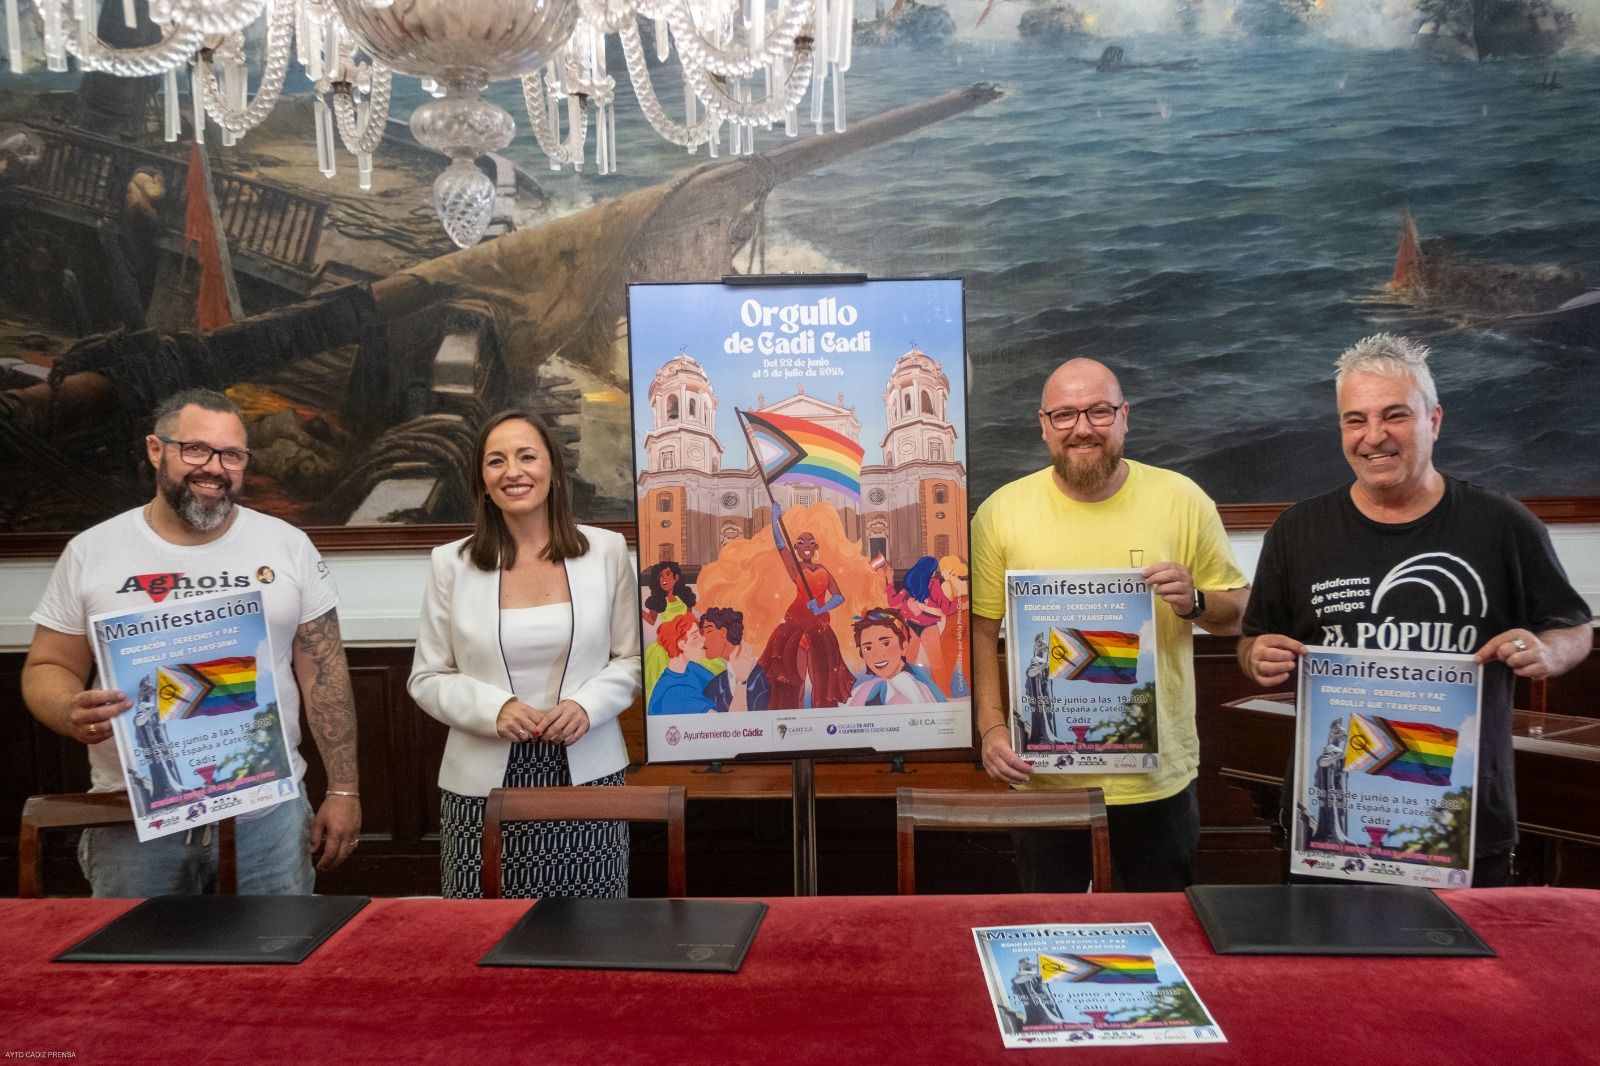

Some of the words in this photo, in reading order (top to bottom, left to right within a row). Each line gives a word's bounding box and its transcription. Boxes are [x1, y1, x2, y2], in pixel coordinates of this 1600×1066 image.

[740, 296, 858, 334] Orgullo
[724, 332, 754, 354] de
[758, 330, 816, 355] Cadi
[820, 330, 872, 353] Cadi
[764, 358, 778, 368] Del
[780, 358, 792, 367] 22
[794, 358, 806, 367] de
[807, 358, 830, 368] junio
[752, 369, 760, 378] al
[771, 368, 782, 378] de
[784, 368, 803, 380] julio
[805, 368, 817, 377] de
[819, 367, 844, 377] 2024
[116, 571, 250, 595] Aghois
[1015, 578, 1147, 596] Manifestación
[1311, 577, 1370, 593] Plataforma
[1311, 595, 1324, 605] de
[1326, 587, 1371, 601] vecinos
[1024, 603, 1060, 611] EDUCACIÓN
[1315, 608, 1322, 618] y
[1323, 600, 1366, 614] amigos
[105, 600, 259, 641] Manifestación
[1078, 614, 1123, 622] TRANSFORMA
[1357, 616, 1478, 653] PÓPULO
[120, 639, 166, 656] EDUCACIÓN
[173, 630, 214, 646] DERECHOS
[132, 652, 167, 666] ORGULLO
[169, 648, 185, 658] QUE
[188, 639, 238, 655] TRANSFORMA
[1310, 658, 1474, 684] Manifestación
[1064, 696, 1088, 706] junio
[1098, 696, 1112, 704] las
[1374, 689, 1417, 699] DERECHOS
[1062, 706, 1091, 714] España
[1329, 698, 1365, 708] ORGULLO
[1368, 701, 1384, 710] QUE
[1387, 702, 1442, 713] TRANSFORMA
[182, 734, 209, 750] junio
[219, 728, 234, 738] las
[683, 730, 731, 741] Ayuntamiento
[732, 729, 741, 738] de
[742, 728, 763, 738] Cádiz
[182, 744, 213, 758] España
[1360, 791, 1390, 804] junio
[1402, 795, 1418, 806] las
[1356, 802, 1390, 814] España
[987, 927, 1148, 940] Manifestación
[1114, 990, 1132, 998] las
